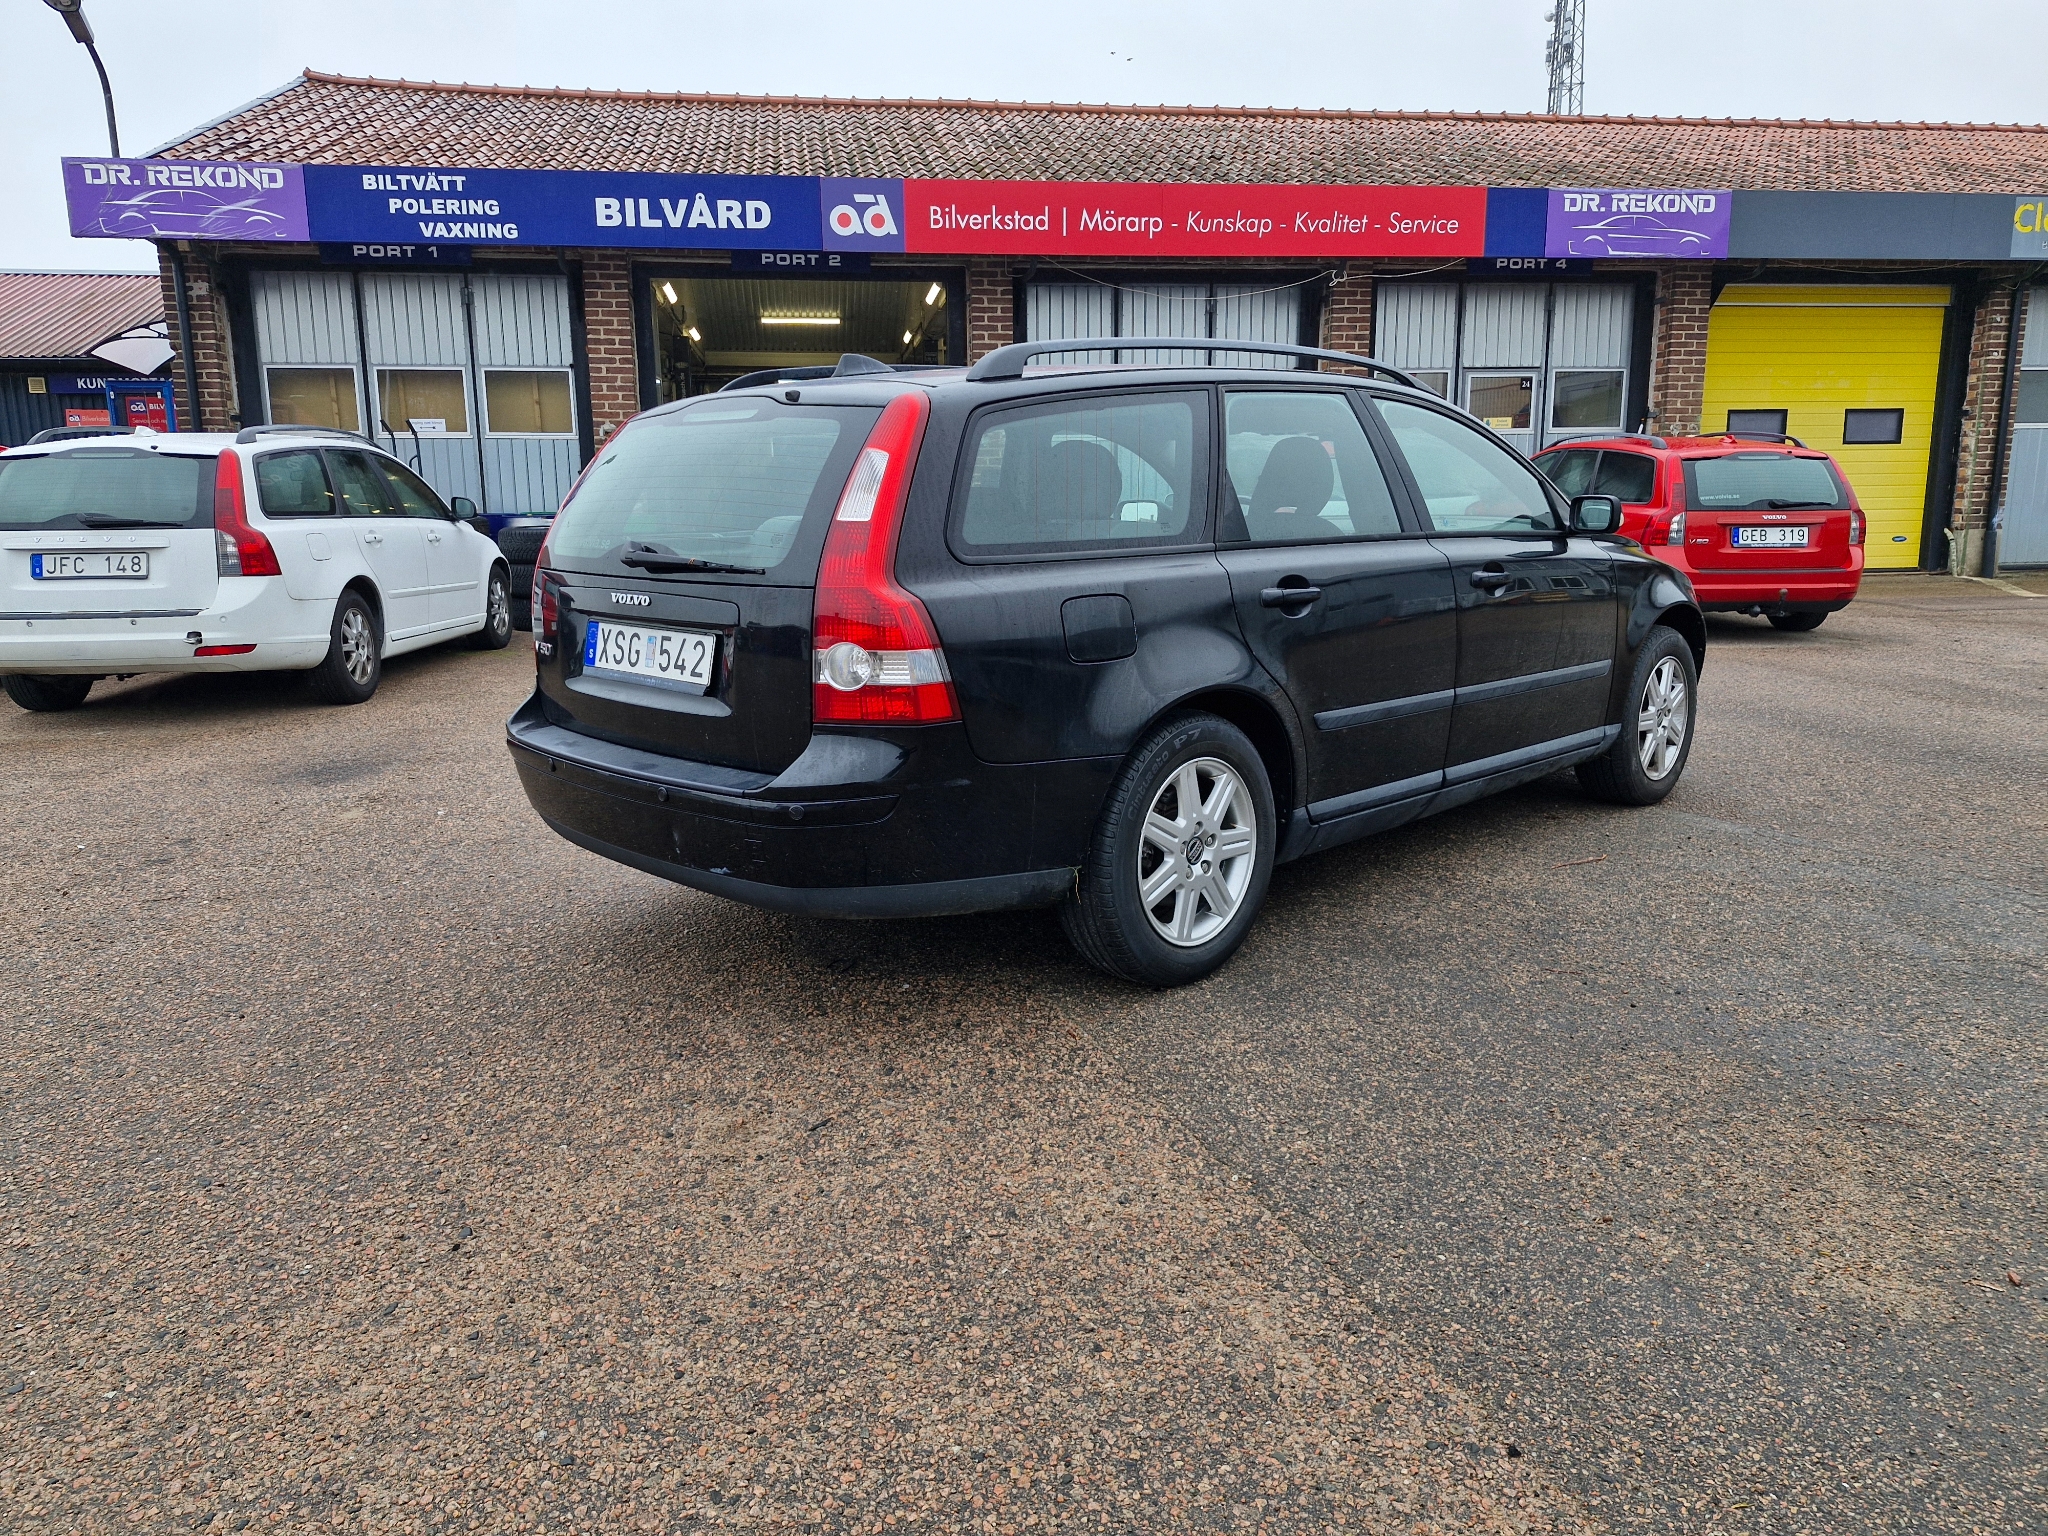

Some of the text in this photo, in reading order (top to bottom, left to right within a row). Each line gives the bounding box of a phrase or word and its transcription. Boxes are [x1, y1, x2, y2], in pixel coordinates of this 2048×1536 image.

[84, 163, 284, 191] DR. REKOND
[362, 172, 466, 192] BILTVÄTT
[388, 198, 500, 216] POLERING
[594, 192, 772, 230] BILVÅRD
[1564, 193, 1716, 216] DR. REKOND
[418, 222, 519, 239] VAXNING
[929, 205, 1050, 232] Bilverkstad
[1079, 208, 1164, 238] Mörarp
[1186, 211, 1273, 238] Kunskap
[1294, 212, 1368, 234] Kvalitet
[1388, 212, 1460, 235] Service
[352, 244, 439, 259] PORT 1
[761, 253, 842, 267] PORT 2
[1495, 258, 1568, 270] PORT 4
[1521, 380, 1530, 388] 24
[1741, 529, 1767, 542] GEB
[1779, 529, 1805, 542] 319
[46, 556, 85, 575] JFC
[104, 555, 142, 574] 148
[610, 592, 651, 607] VOLVO
[588, 627, 706, 679] S XSG 542
